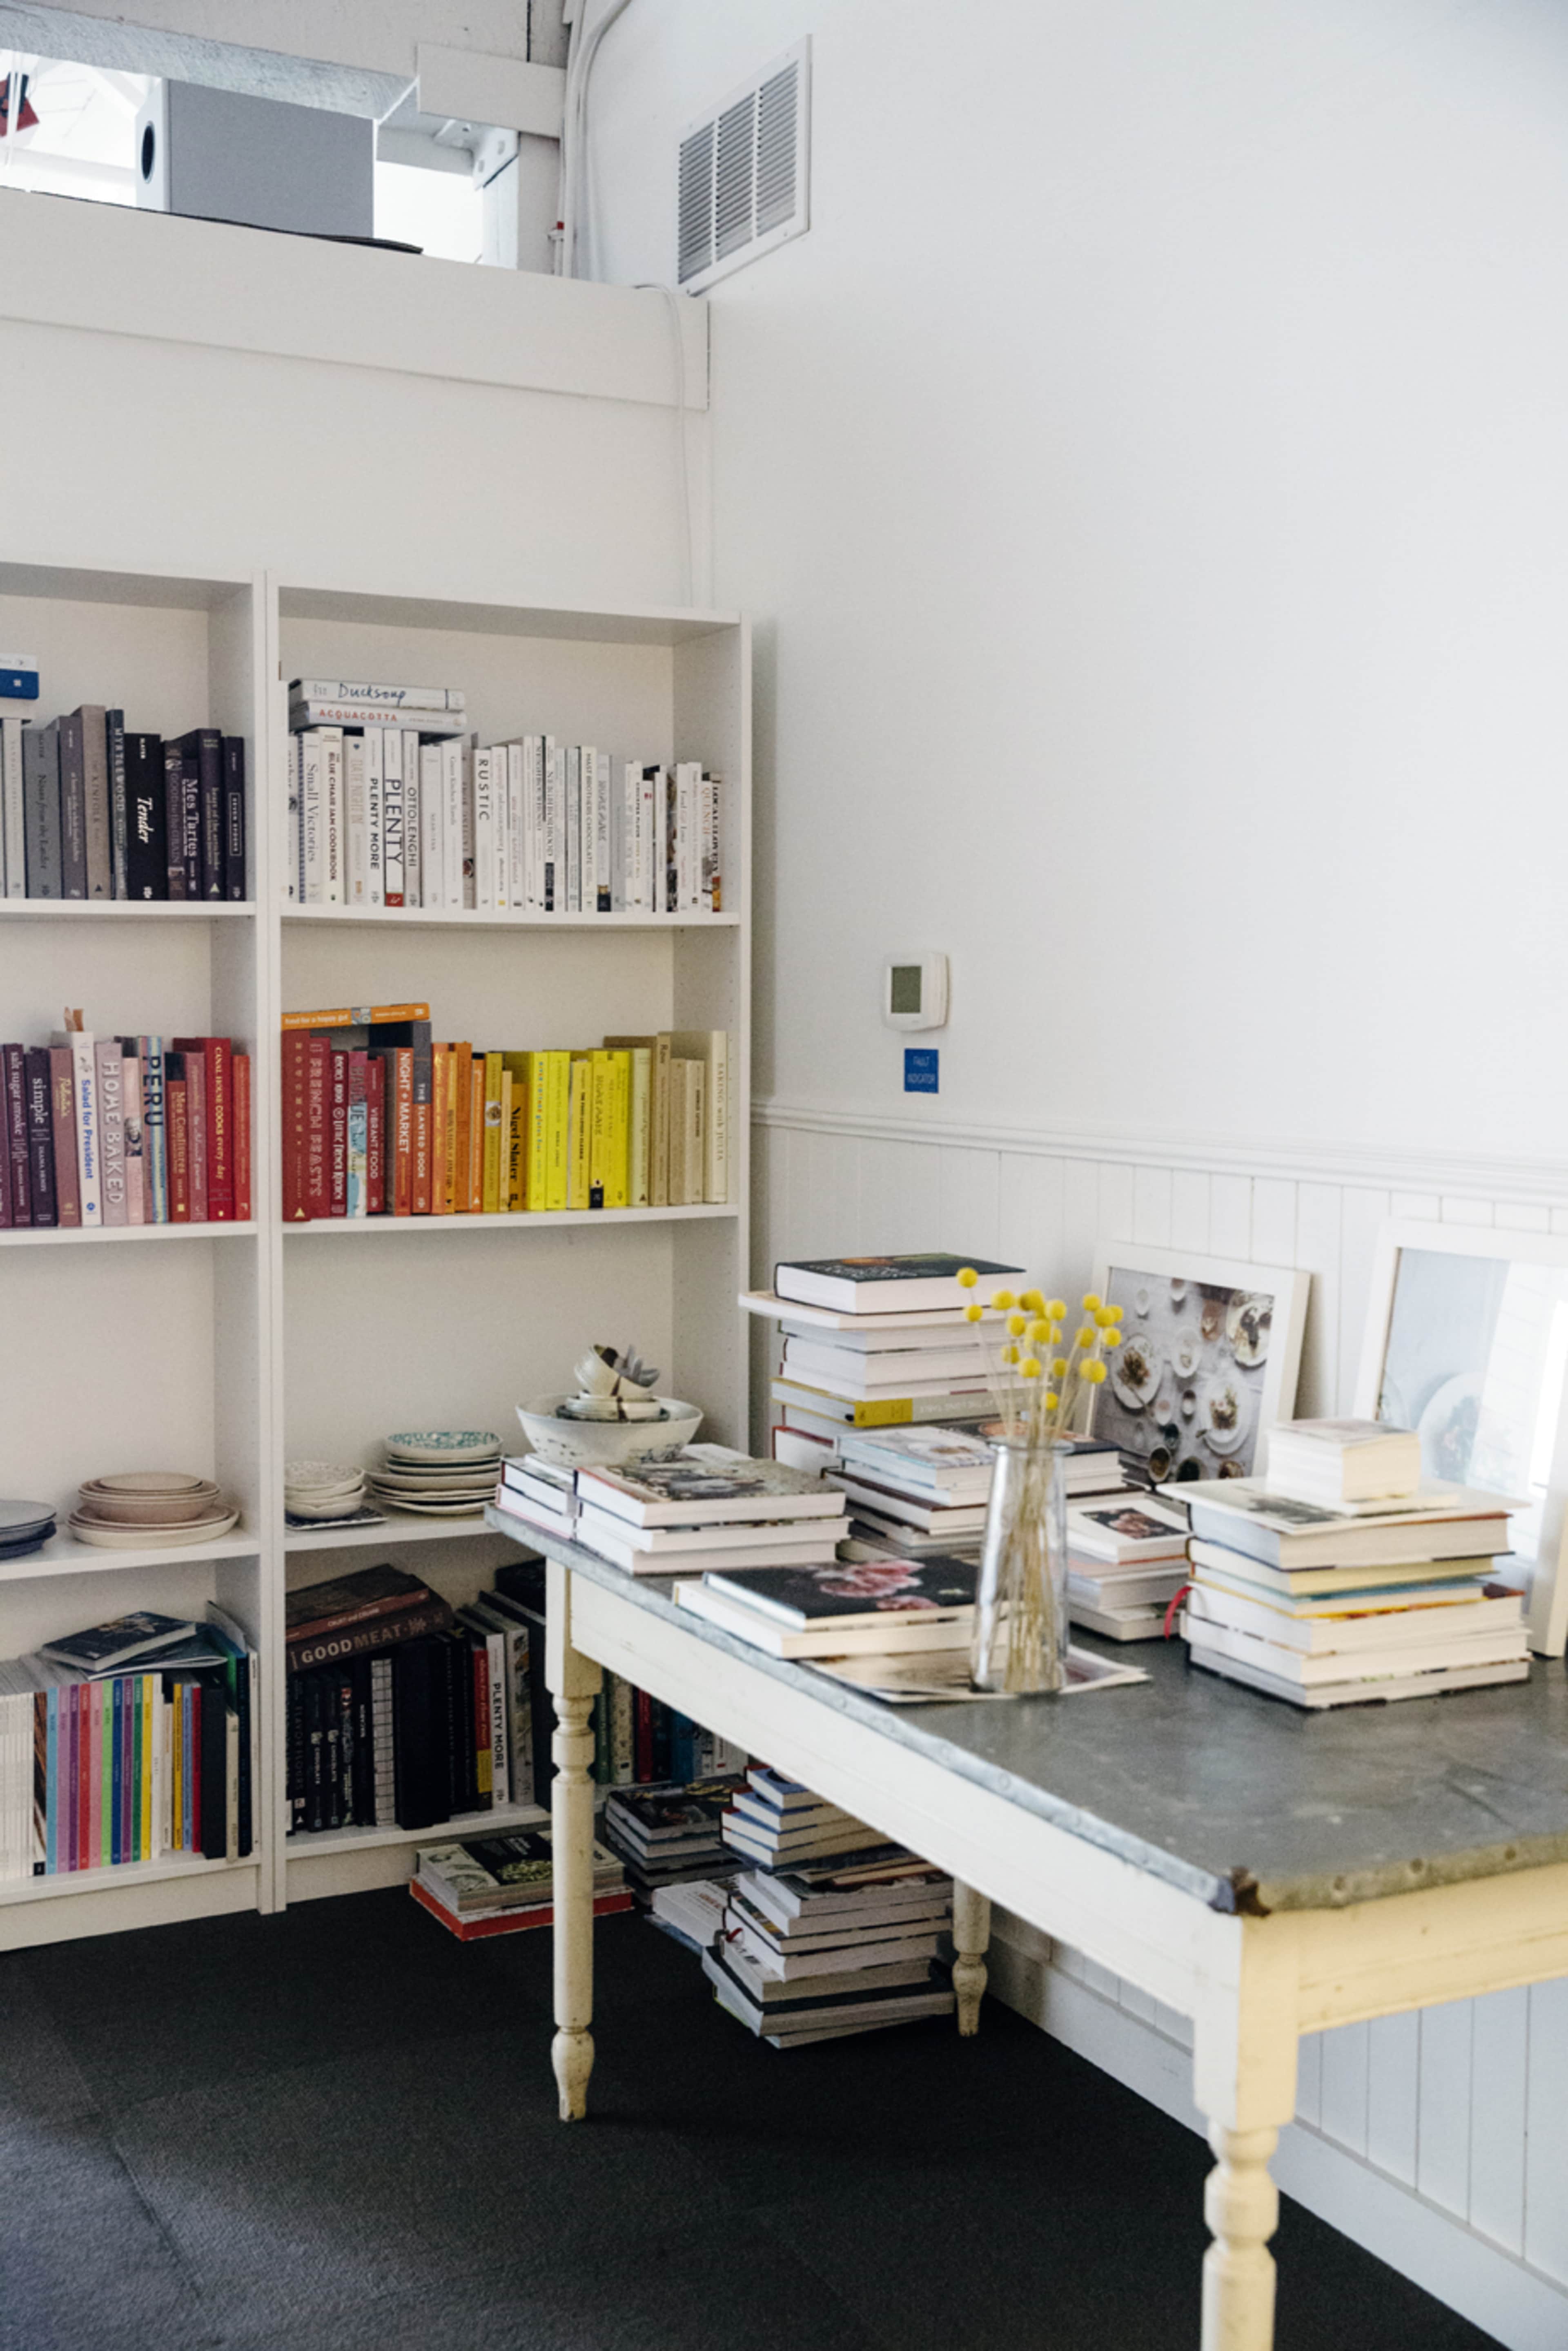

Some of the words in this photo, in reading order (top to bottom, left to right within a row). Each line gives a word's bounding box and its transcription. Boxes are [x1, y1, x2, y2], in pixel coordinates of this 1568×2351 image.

[320, 709, 398, 722] ACQUACOTTA
[338, 683, 406, 707] Ducksoup
[115, 727, 125, 812] MYRTLEWOOD
[169, 773, 178, 801] GOOD
[306, 763, 319, 801] Small
[478, 758, 490, 821] RUSTIC
[91, 776, 100, 824] KINFOLK
[186, 778, 198, 809] Mes
[370, 777, 379, 828] PLENTY
[702, 787, 710, 835] QUENCH
[137, 797, 155, 843] Tender
[187, 812, 200, 857] Tartes
[307, 805, 320, 863] Victories
[385, 778, 402, 865] PLENTY
[407, 787, 417, 867] OTTOLENGHI
[171, 830, 180, 863] GRAIN
[329, 827, 337, 881] COOKBOOK
[370, 832, 379, 870] MORE
[11, 1052, 22, 1069] salt
[215, 1047, 223, 1073] CANAL
[399, 1052, 411, 1091] NIGHT
[659, 1044, 668, 1064] Raw
[9, 1071, 21, 1099] sugar
[30, 1078, 48, 1124] simple
[81, 1079, 91, 1109] Salad
[102, 1062, 120, 1124] HOME
[142, 1056, 164, 1127] PERU
[176, 1092, 185, 1114] Mes
[309, 1057, 323, 1129] FRENCH
[350, 1066, 364, 1121] BASQUE
[13, 1101, 26, 1135] smoke
[82, 1111, 92, 1126] for
[216, 1105, 224, 1135] COOKS
[370, 1107, 378, 1149] VIBRANT
[399, 1101, 411, 1154] MARKET
[510, 1106, 522, 1140] Nigel
[83, 1129, 94, 1179] President
[177, 1117, 186, 1173] Confitures
[215, 1136, 223, 1160] every
[309, 1134, 323, 1197] FEASTS
[370, 1151, 379, 1179] FOOD
[510, 1142, 522, 1183] Slater
[716, 1132, 724, 1162] JULIA
[105, 1132, 124, 1203] BAKED
[216, 1164, 226, 1180] day
[493, 1682, 503, 1730] PLENTY
[494, 1734, 504, 1770] MORE
